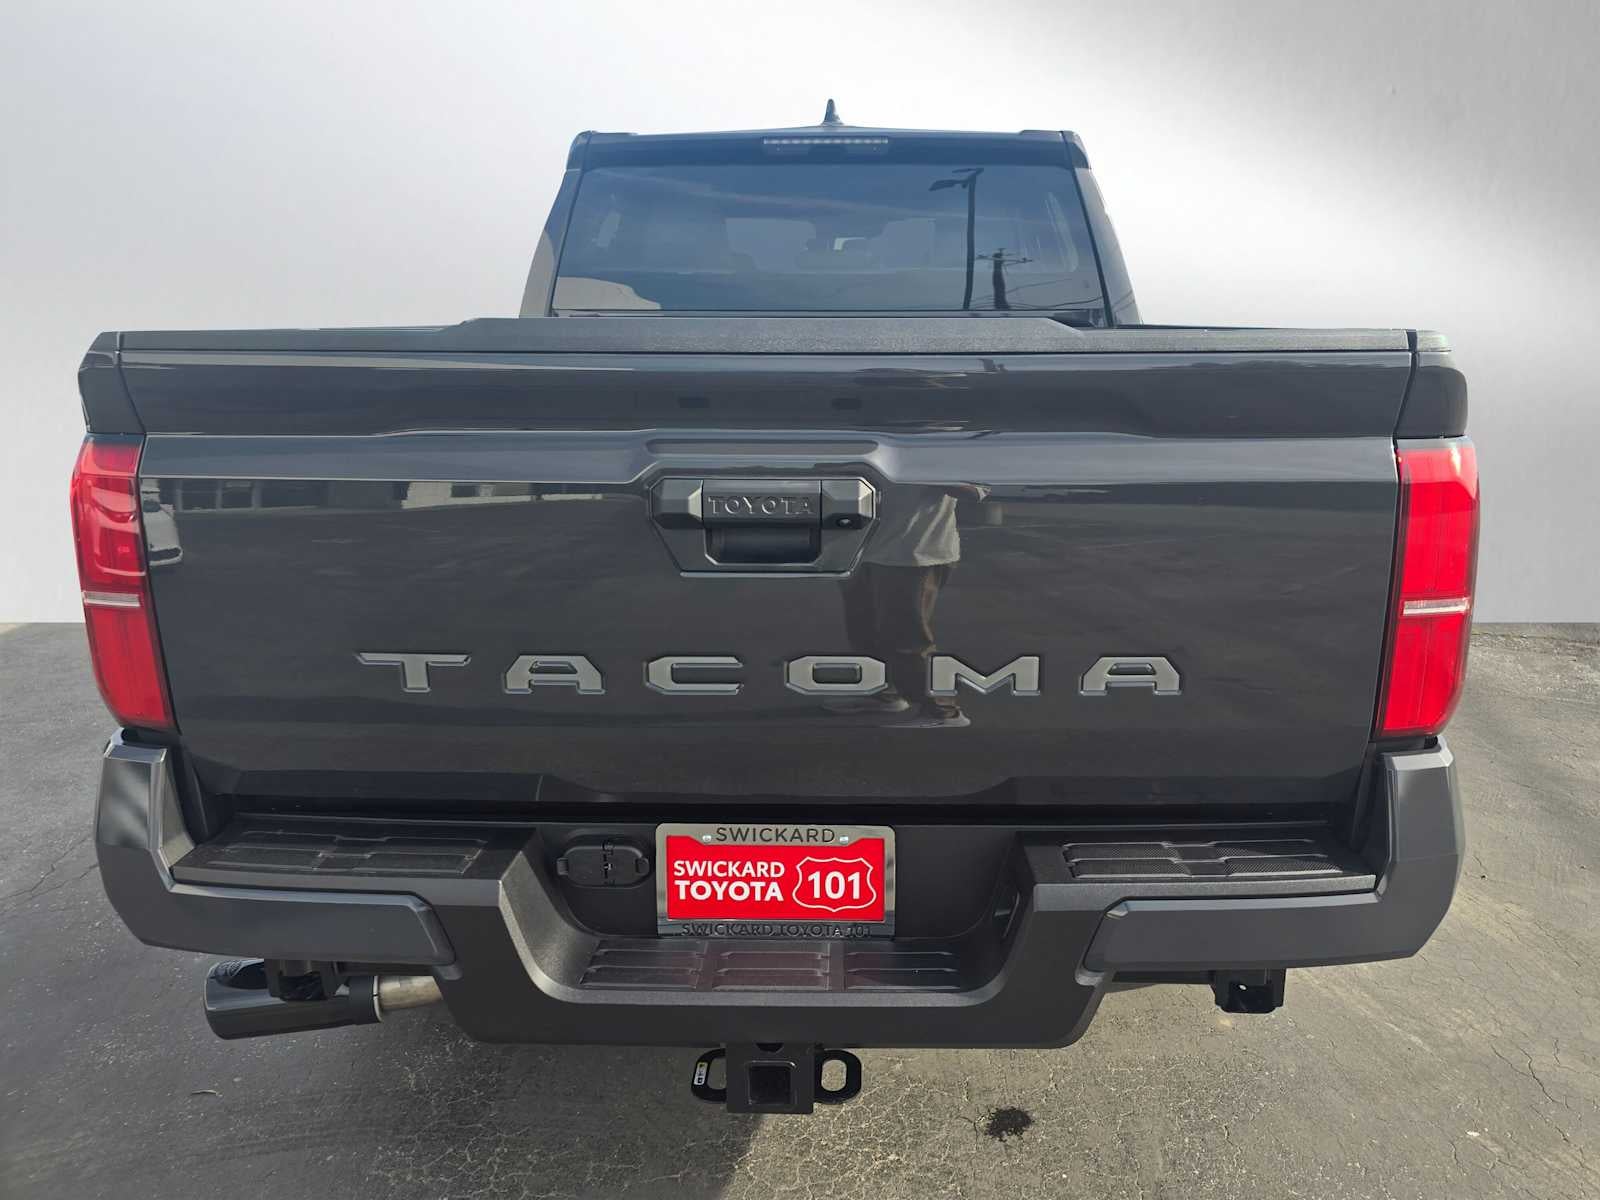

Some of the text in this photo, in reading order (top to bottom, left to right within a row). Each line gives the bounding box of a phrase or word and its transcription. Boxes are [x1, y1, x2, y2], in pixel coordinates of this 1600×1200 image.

[707, 496, 814, 514] TOYOTA
[354, 652, 1182, 695] TACOMA
[715, 827, 835, 843] SWICKARD
[673, 860, 785, 878] SWICKARD
[674, 880, 784, 901] TOYOTA
[807, 870, 862, 900] 101
[681, 923, 773, 937] SWICKARD
[779, 923, 843, 938] TOYOTA
